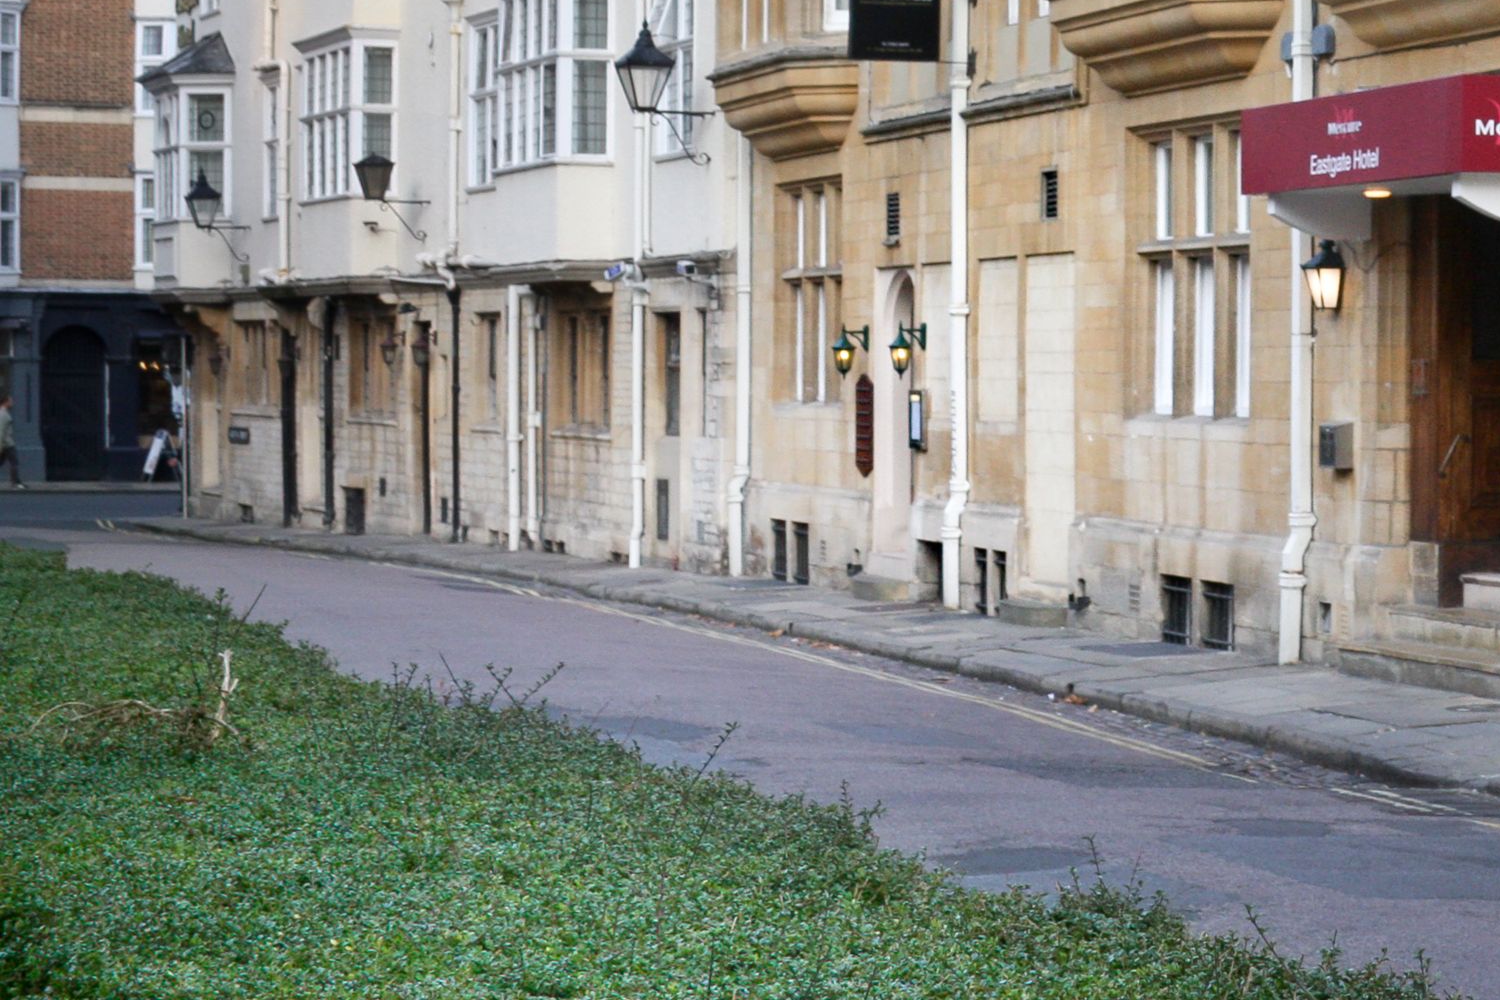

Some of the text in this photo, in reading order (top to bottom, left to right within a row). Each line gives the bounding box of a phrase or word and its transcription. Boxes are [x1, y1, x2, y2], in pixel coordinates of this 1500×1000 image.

[1327, 121, 1363, 135] Mercure
[1310, 147, 1379, 178] Eastgate Hotel
